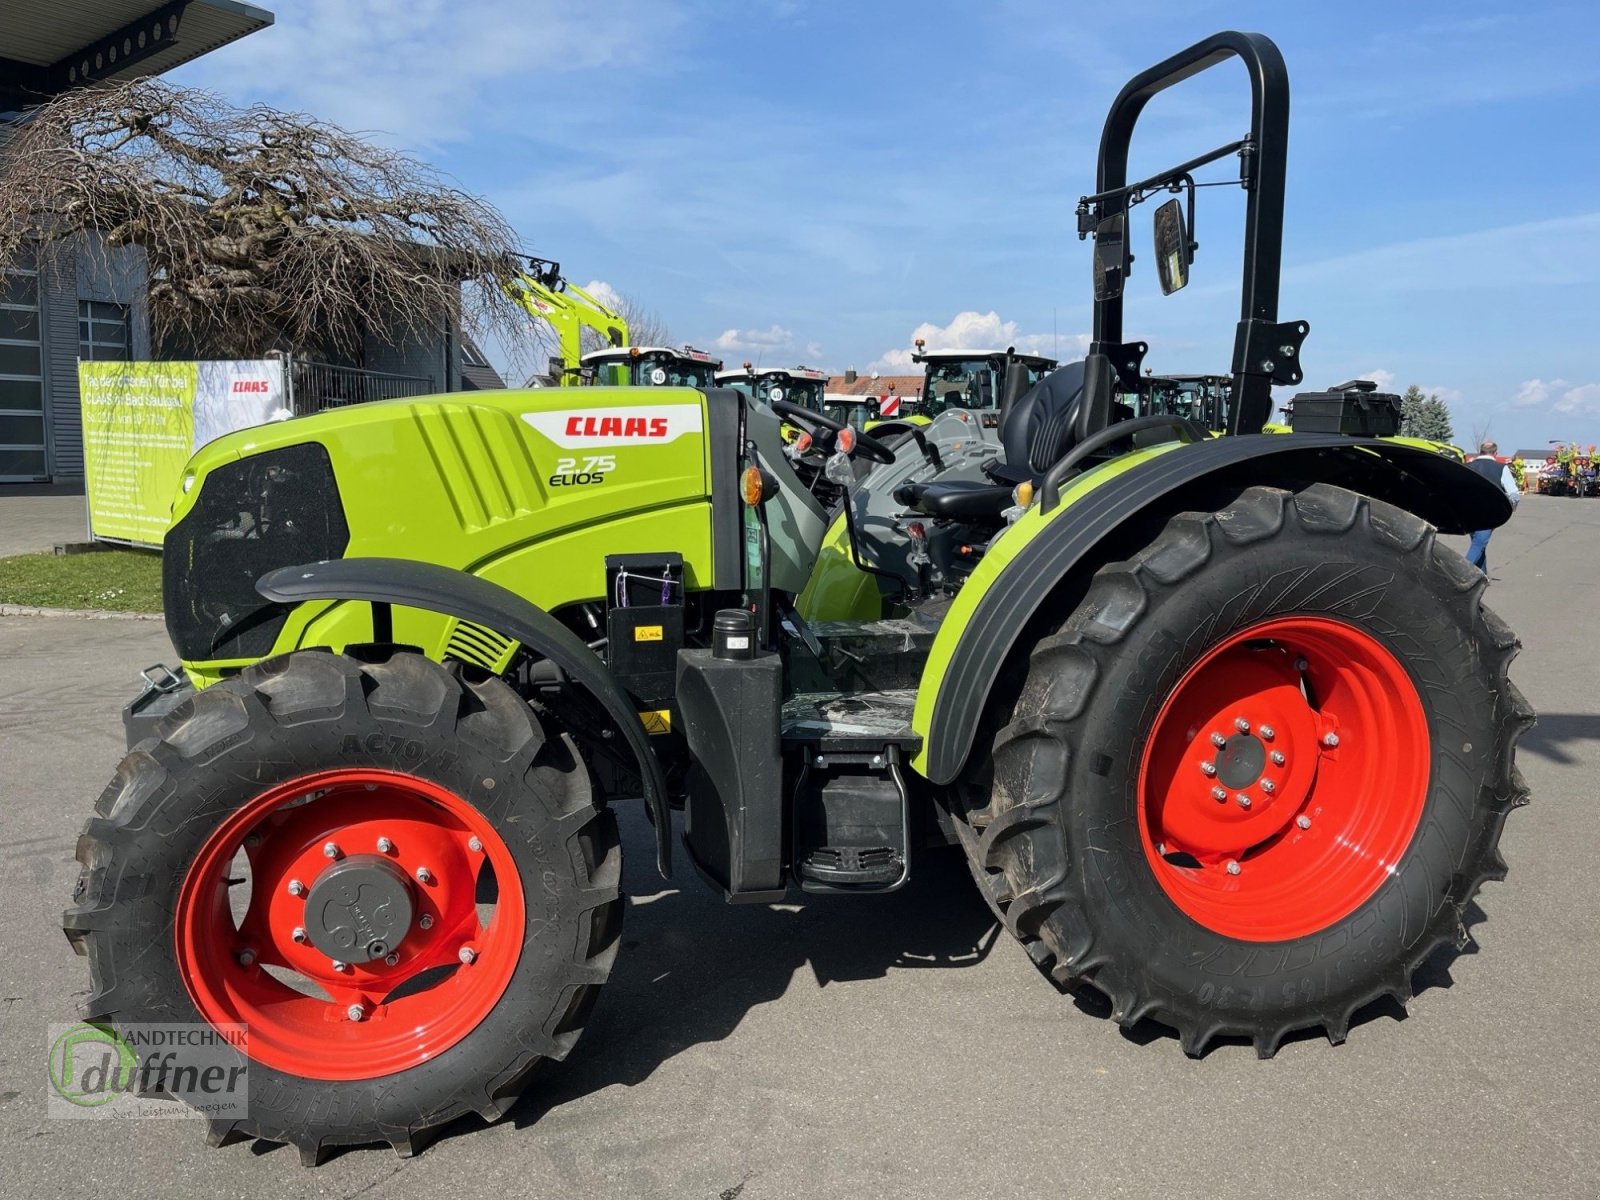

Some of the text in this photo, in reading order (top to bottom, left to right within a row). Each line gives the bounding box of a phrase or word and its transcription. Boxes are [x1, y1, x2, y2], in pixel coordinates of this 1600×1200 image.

[654, 372, 664, 382] 40
[233, 381, 269, 393] CLAAS
[773, 390, 781, 399] 40
[565, 416, 668, 437] CLAAS
[556, 455, 617, 475] 2.75
[549, 472, 604, 486] ELIOS
